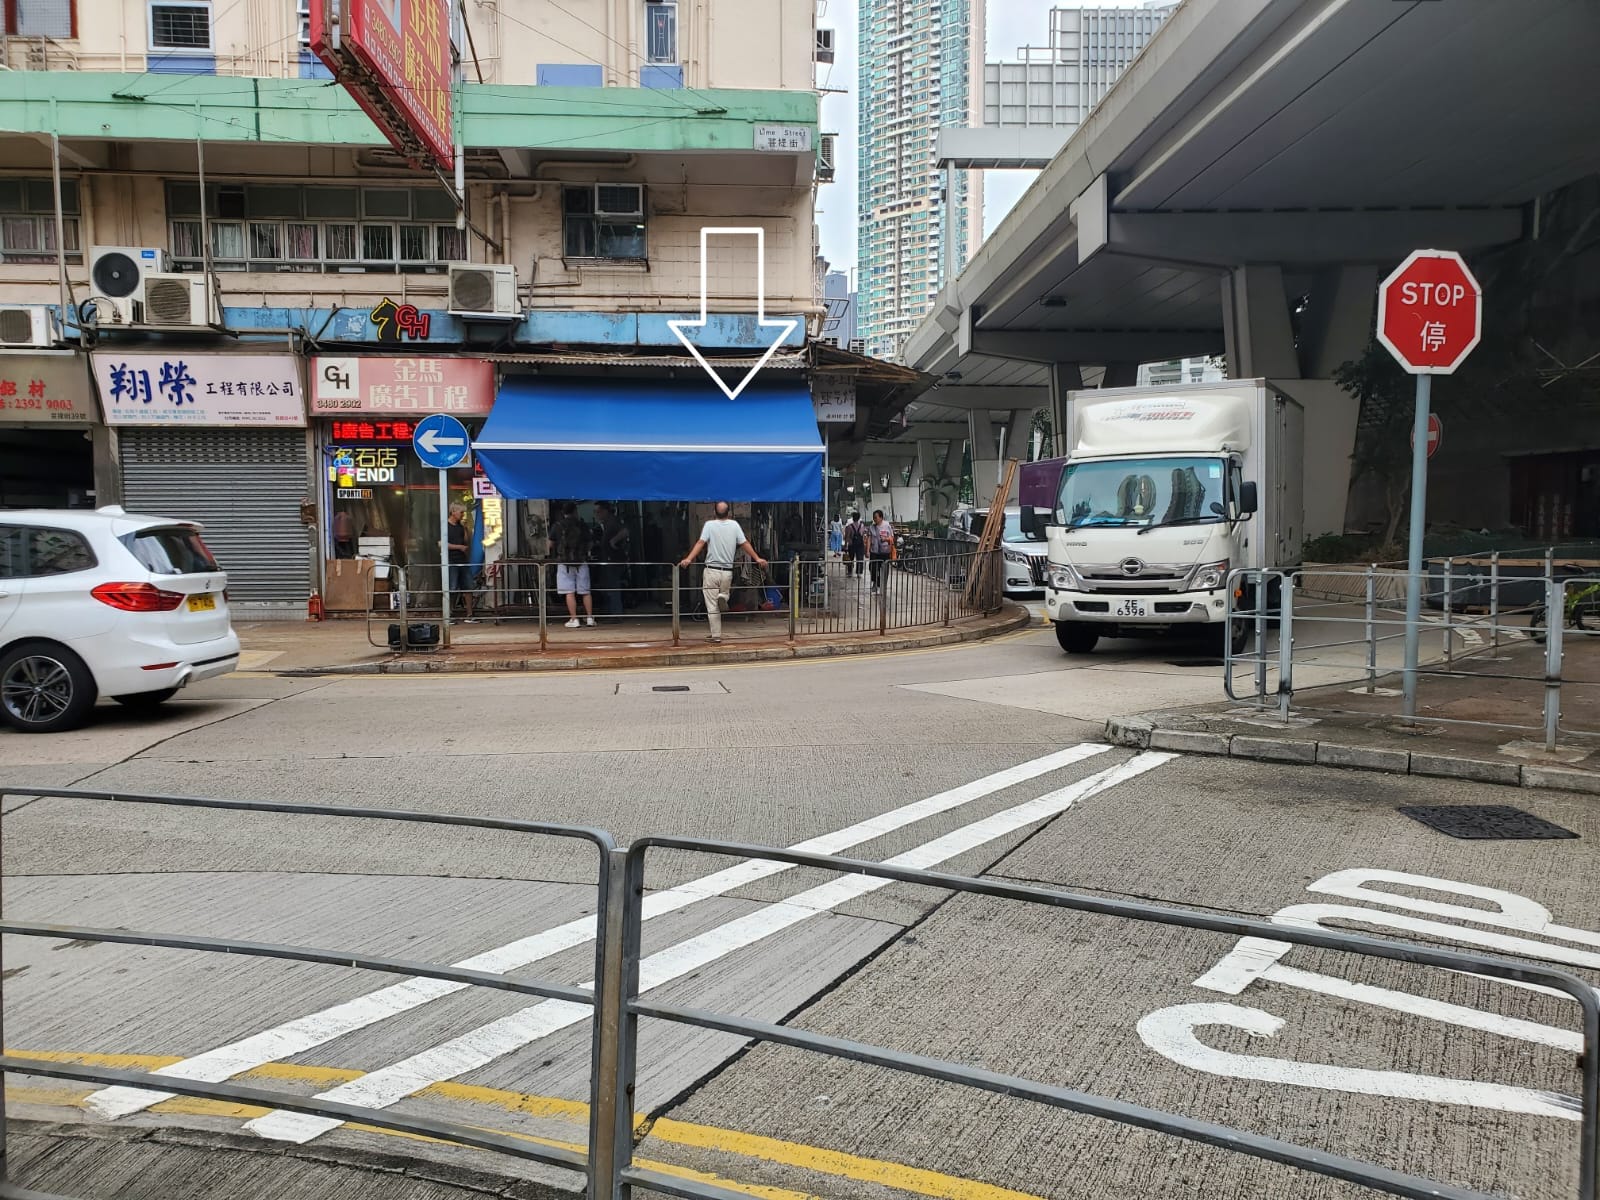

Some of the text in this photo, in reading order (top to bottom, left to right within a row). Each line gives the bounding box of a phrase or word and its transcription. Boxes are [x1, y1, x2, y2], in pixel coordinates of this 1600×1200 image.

[405, 30, 446, 137] 廣告工程
[759, 128, 806, 137] Lime Street
[1401, 282, 1465, 306] STOP
[394, 304, 430, 338] GH
[1420, 321, 1446, 352] 停
[324, 365, 350, 390] GH
[394, 357, 444, 383] 金馬
[109, 360, 295, 407] 翔榮 工程有限公司
[340, 400, 361, 409] 2902
[369, 384, 469, 410] 廣告工程
[1117, 608, 1145, 617] 6398
[1124, 600, 1138, 608] ZE
